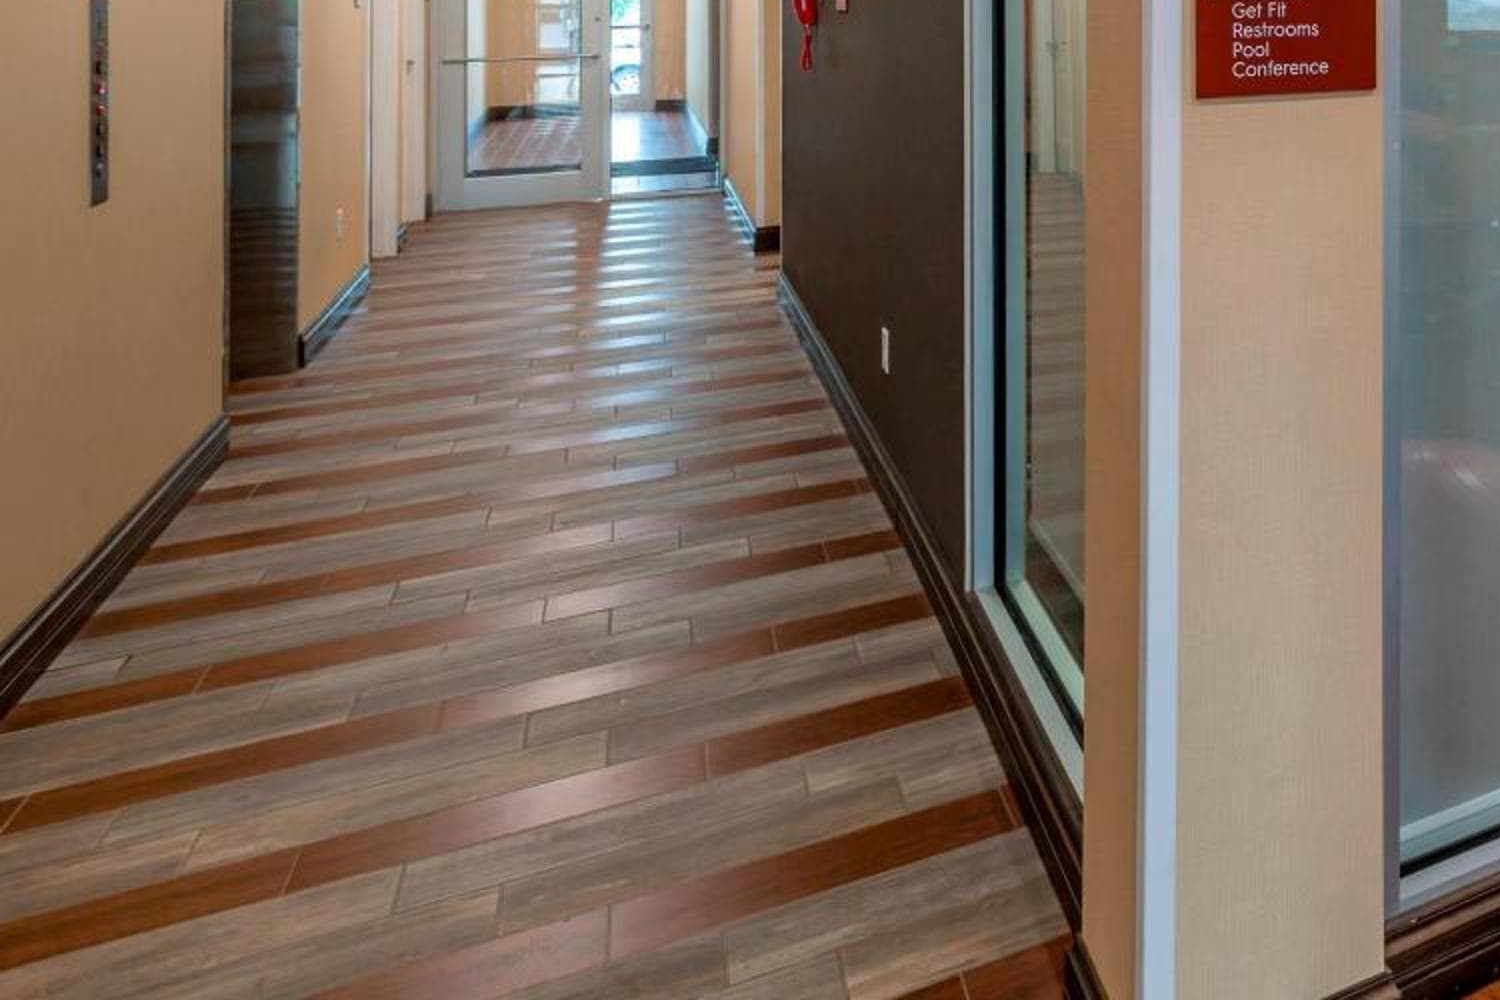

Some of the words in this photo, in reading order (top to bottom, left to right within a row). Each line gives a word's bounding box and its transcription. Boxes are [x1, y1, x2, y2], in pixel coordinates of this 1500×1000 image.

[1231, 1, 1264, 19] Get
[1267, 1, 1287, 18] Fit
[1232, 21, 1320, 38] Restrooms
[1232, 42, 1270, 58] Pool
[1231, 60, 1329, 79] Conference
